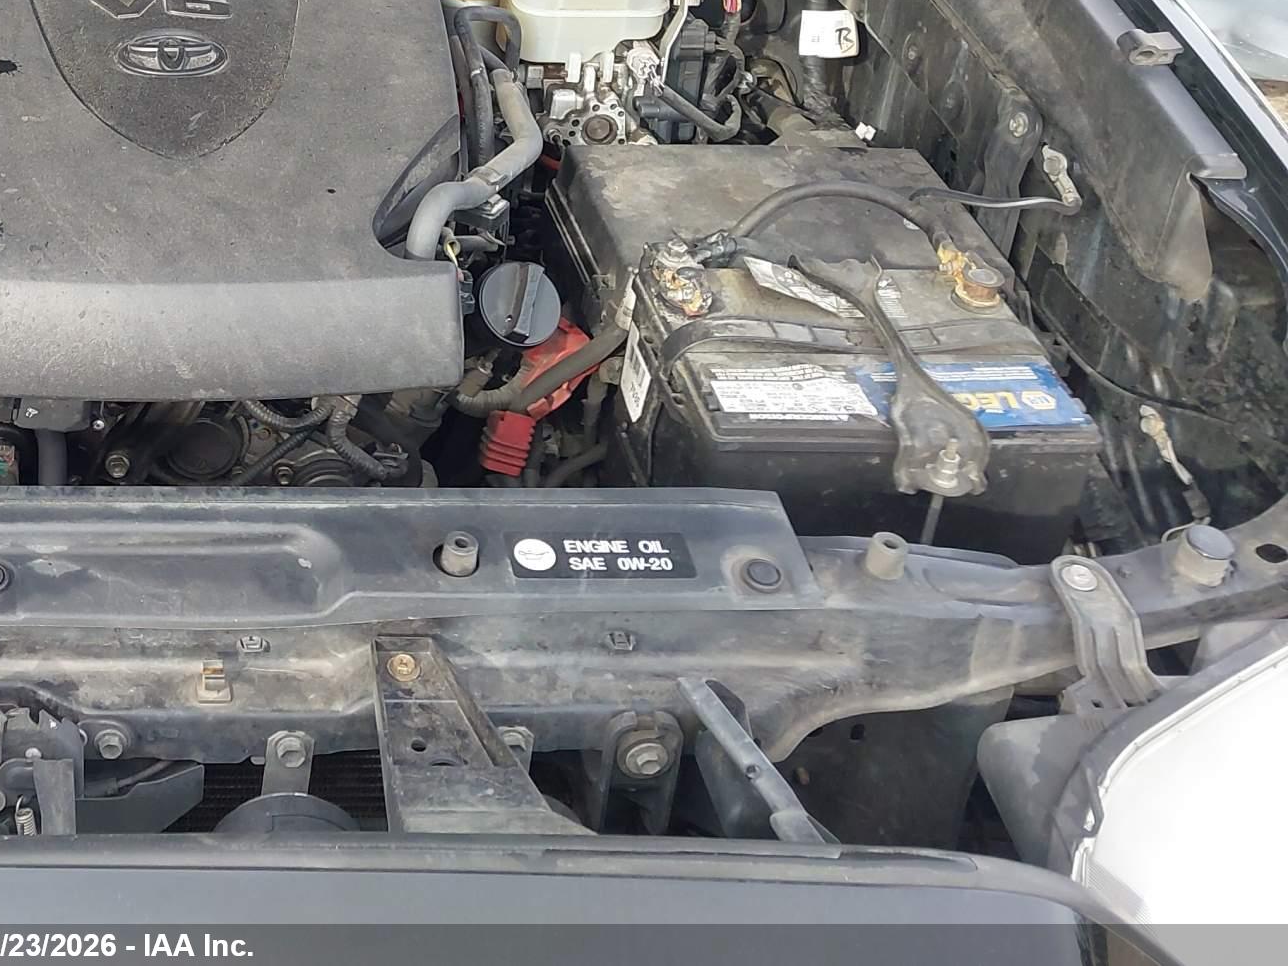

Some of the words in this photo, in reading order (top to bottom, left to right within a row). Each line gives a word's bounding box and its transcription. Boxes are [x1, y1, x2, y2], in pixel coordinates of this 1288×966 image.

[563, 540, 630, 553] ENGINE
[638, 540, 669, 553] OIL
[569, 557, 607, 571] SAE
[617, 557, 673, 571] 0W-20
